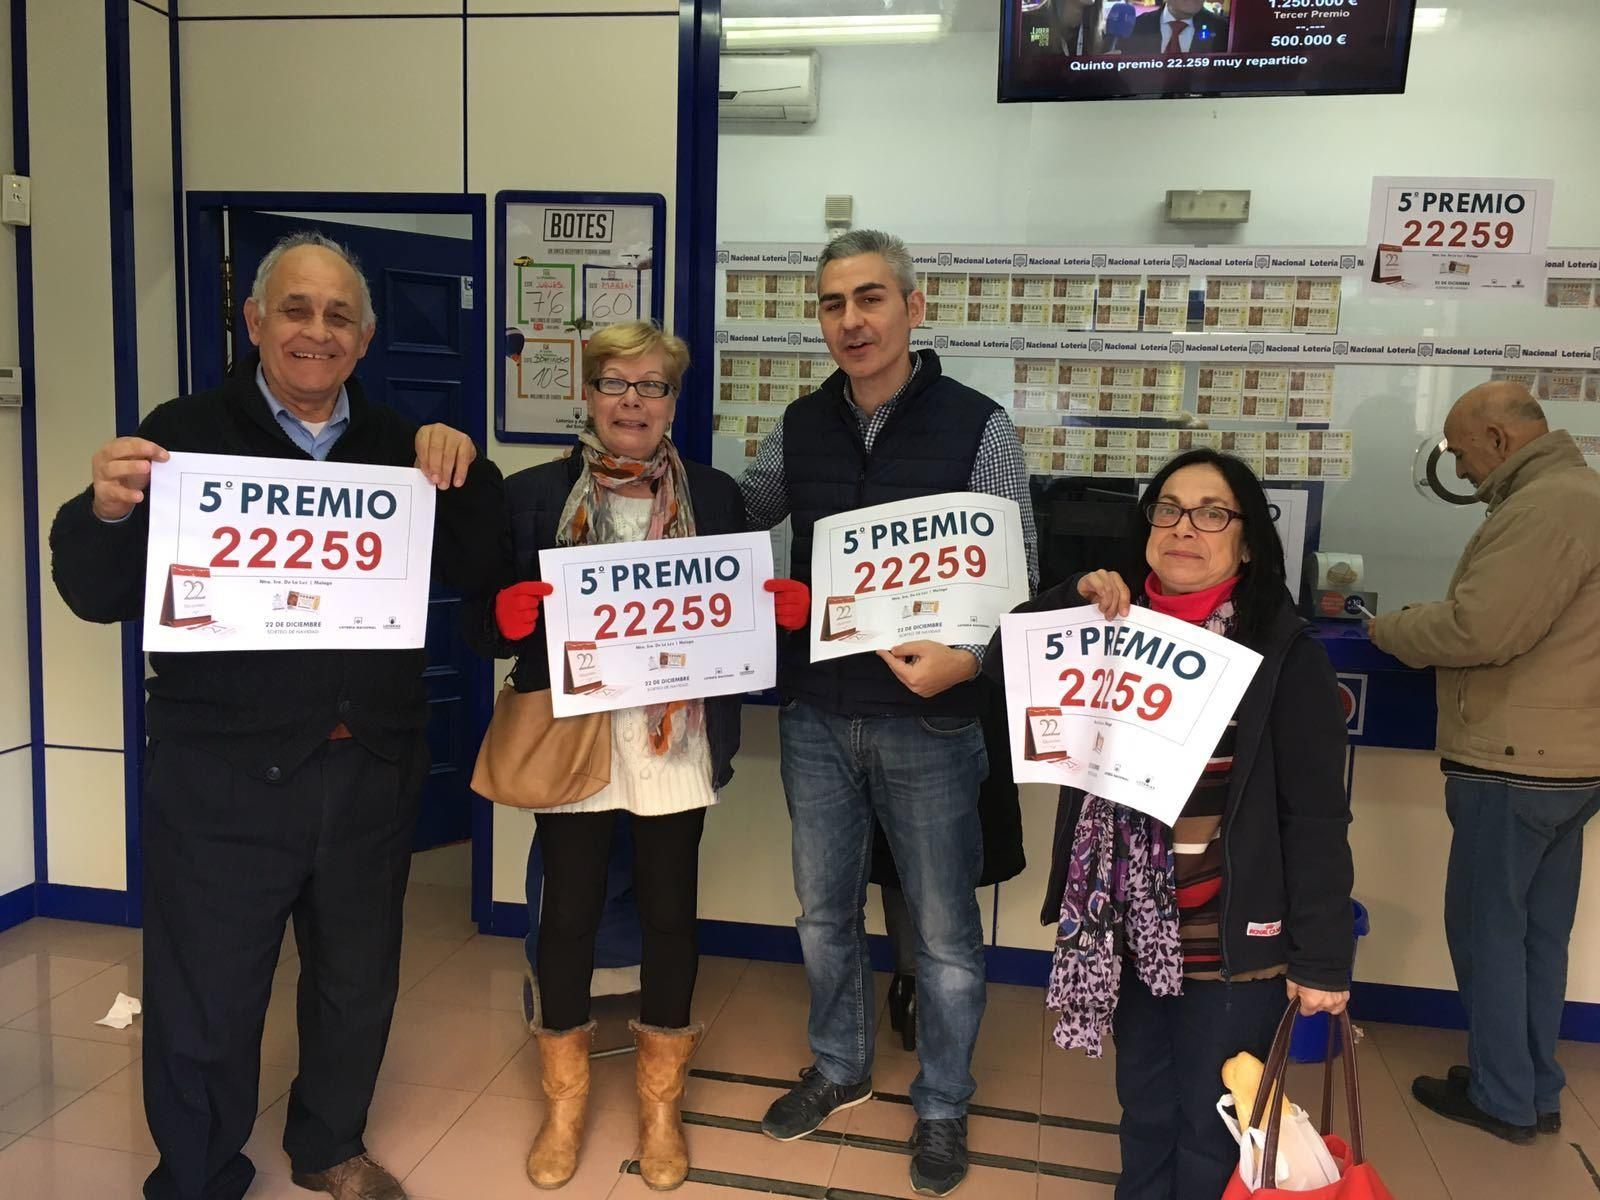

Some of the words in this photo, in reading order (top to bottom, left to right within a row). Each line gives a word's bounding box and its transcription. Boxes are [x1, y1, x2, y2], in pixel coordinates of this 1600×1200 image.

[1274, 11, 1308, 19] Tercer
[1311, 10, 1350, 18] Premio
[1271, 34, 1332, 46] 500.000
[1336, 34, 1347, 45] €
[1070, 61, 1114, 71] Quinto
[1117, 60, 1163, 71] premio
[1167, 58, 1209, 68] 22.259
[1214, 58, 1242, 69] muy
[1246, 54, 1308, 68] repartido
[1423, 192, 1525, 214] PREMIO
[551, 213, 607, 239] BOTES
[1402, 220, 1514, 249] 22259
[730, 254, 760, 262] Nacional
[762, 253, 787, 262] Lotería
[953, 257, 984, 265] Nacional
[985, 256, 1012, 265] Lotería
[1063, 257, 1091, 266] Lotería
[1108, 258, 1141, 266] Nacional
[1143, 258, 1170, 266] Lotería
[1188, 258, 1222, 266] Nacional
[1225, 258, 1253, 267] Lotería
[1271, 259, 1306, 267] Nacional
[1309, 259, 1338, 267] Lotería
[1386, 253, 1399, 266] 22
[1545, 260, 1565, 268] ional
[1567, 260, 1597, 268] Lotería
[592, 293, 633, 318] 60
[730, 334, 759, 342] Nacional
[762, 334, 787, 343] Lotería
[983, 339, 1009, 348] Lotería
[1026, 341, 1057, 349] Nacional
[1060, 341, 1087, 349] Lotería
[1104, 342, 1137, 350] Nacional
[1140, 343, 1168, 351] Lotería
[1185, 344, 1219, 352] Nacional
[1219, 344, 1248, 352] Lotería
[1303, 344, 1331, 353] Lotería
[1350, 345, 1384, 353] Nacional
[1387, 345, 1416, 354] Lotería
[1435, 347, 1470, 355] Nacional
[1473, 347, 1503, 356] Lotería
[1522, 348, 1557, 357] Nacional
[1561, 349, 1591, 358] Lotería
[240, 482, 397, 520] PREMIO
[871, 511, 994, 549] PREMIO
[209, 526, 382, 571] 22259
[611, 555, 740, 592] PREMIO
[854, 545, 987, 594] 22259
[184, 580, 206, 600] 22
[593, 592, 732, 641] 22259
[836, 605, 852, 621] 22
[577, 653, 595, 670] 22
[1080, 625, 1207, 680] PREMIO
[661, 676, 690, 684] DICIEMBRE
[1058, 667, 1173, 721] 22259
[1039, 719, 1060, 737] 22
